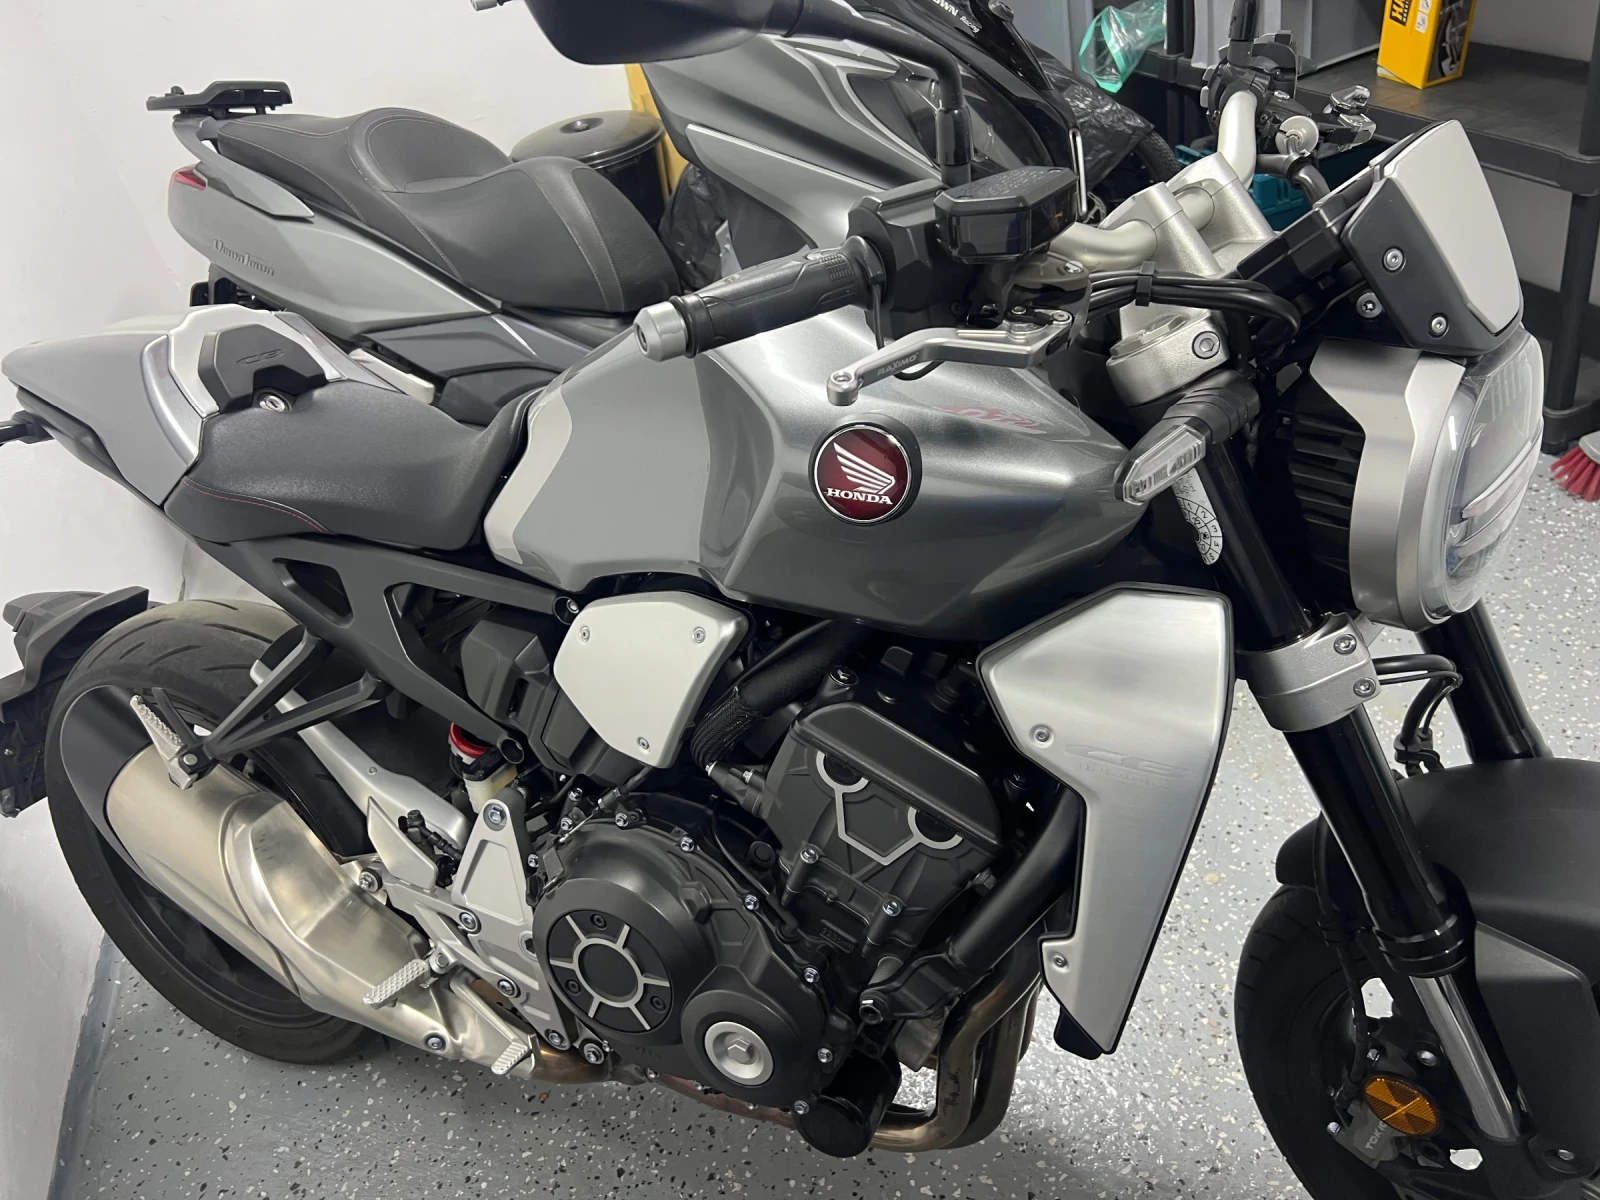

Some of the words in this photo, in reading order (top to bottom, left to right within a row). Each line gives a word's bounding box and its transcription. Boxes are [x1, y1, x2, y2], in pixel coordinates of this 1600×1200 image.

[960, 15, 981, 34] Racing
[877, 354, 917, 377] RAXIMO
[826, 487, 894, 505] HONDA
[1200, 510, 1208, 519] 2
[1211, 524, 1218, 533] 3
[1213, 540, 1220, 548] 4
[1209, 552, 1215, 561] 5
